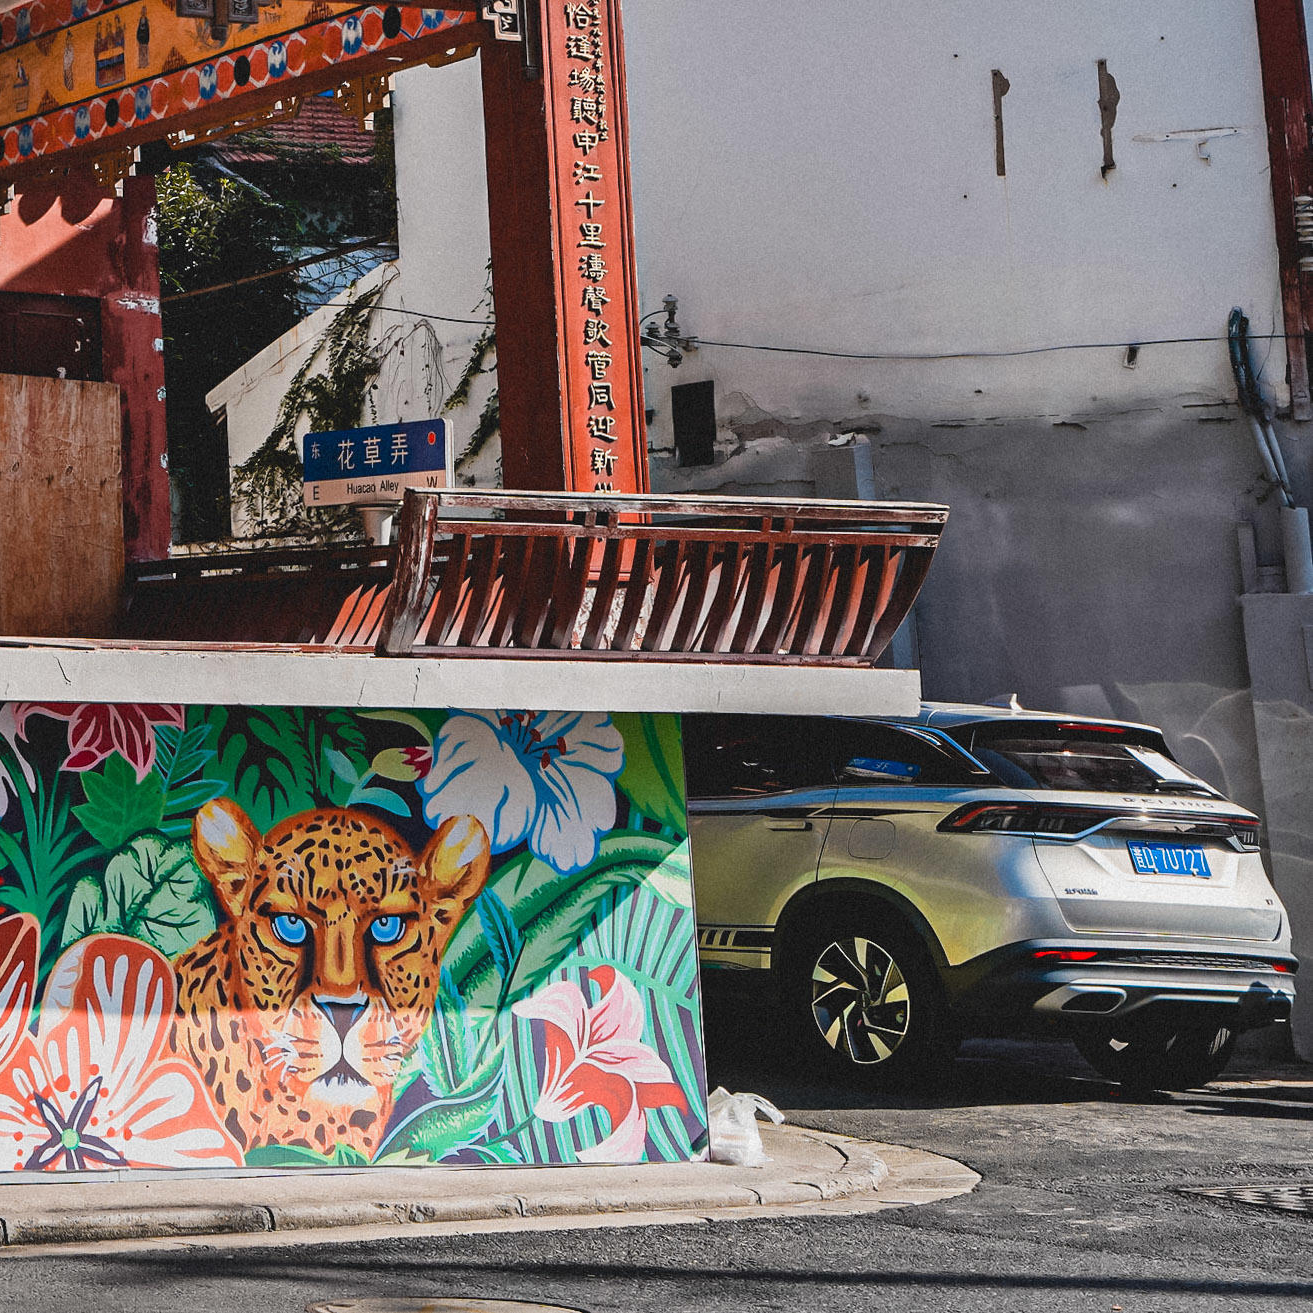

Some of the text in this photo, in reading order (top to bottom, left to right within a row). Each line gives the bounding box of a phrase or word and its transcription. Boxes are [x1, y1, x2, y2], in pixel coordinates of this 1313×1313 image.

[311, 433, 409, 471] 东 花草弄
[312, 476, 438, 500] E Huacao Alley W
